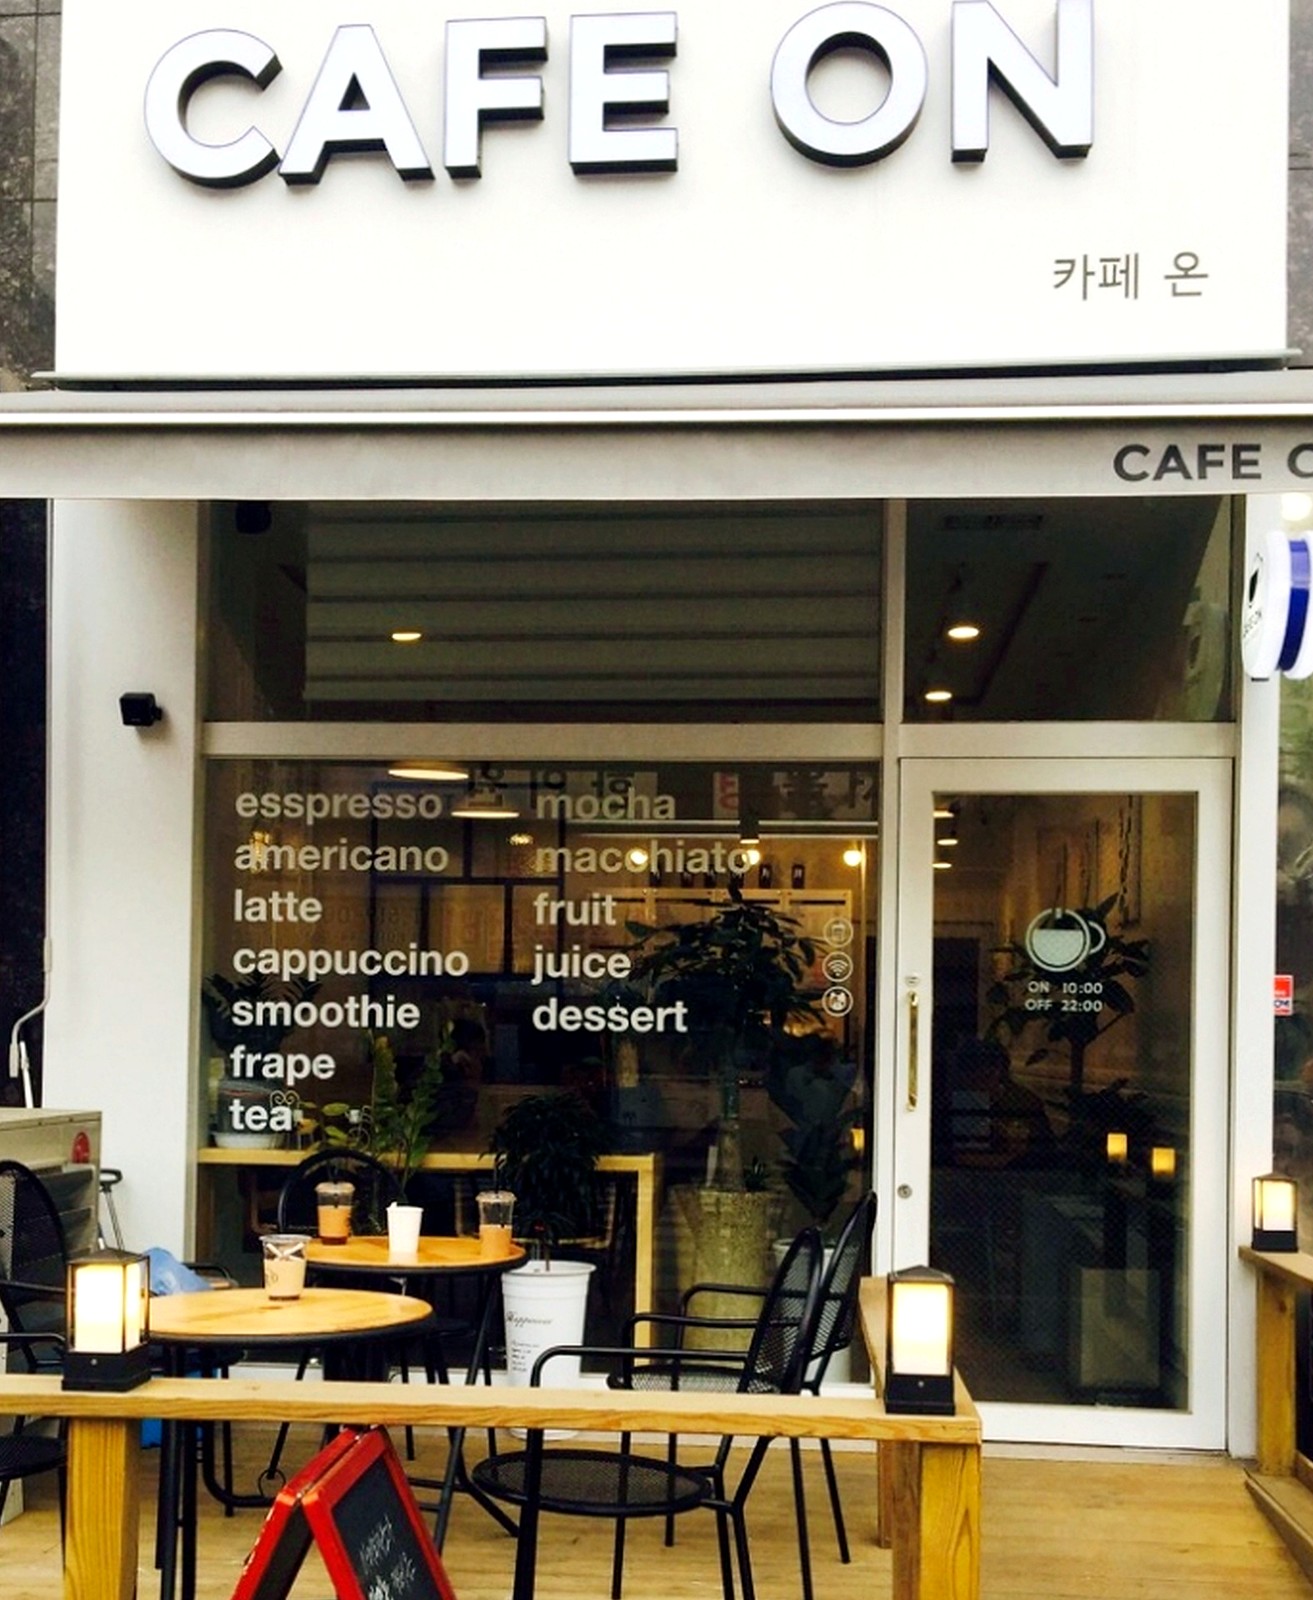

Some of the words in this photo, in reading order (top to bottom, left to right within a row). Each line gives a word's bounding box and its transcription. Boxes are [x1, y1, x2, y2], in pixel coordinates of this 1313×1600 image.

[144, 12, 678, 189] CAFE
[770, 0, 1094, 169] ON
[1053, 252, 1139, 301] 카페
[1163, 251, 1209, 298] 온
[1113, 443, 1262, 482] CAFE
[235, 792, 443, 825] esspresso
[536, 787, 676, 820] mocha
[234, 838, 449, 872] americano
[535, 840, 753, 874] macchiato
[234, 889, 323, 923] latte
[533, 893, 617, 926] fruit
[232, 943, 470, 981] cappuccino
[531, 945, 632, 985] juice
[1028, 980, 1050, 993] ON
[1062, 982, 1103, 994] 10:00
[231, 995, 421, 1029] smoothie
[532, 997, 689, 1033] dessert
[1024, 998, 1052, 1011] OFF
[1060, 999, 1103, 1012] 22:00
[230, 1044, 336, 1086] frape
[229, 1098, 292, 1132] tea
